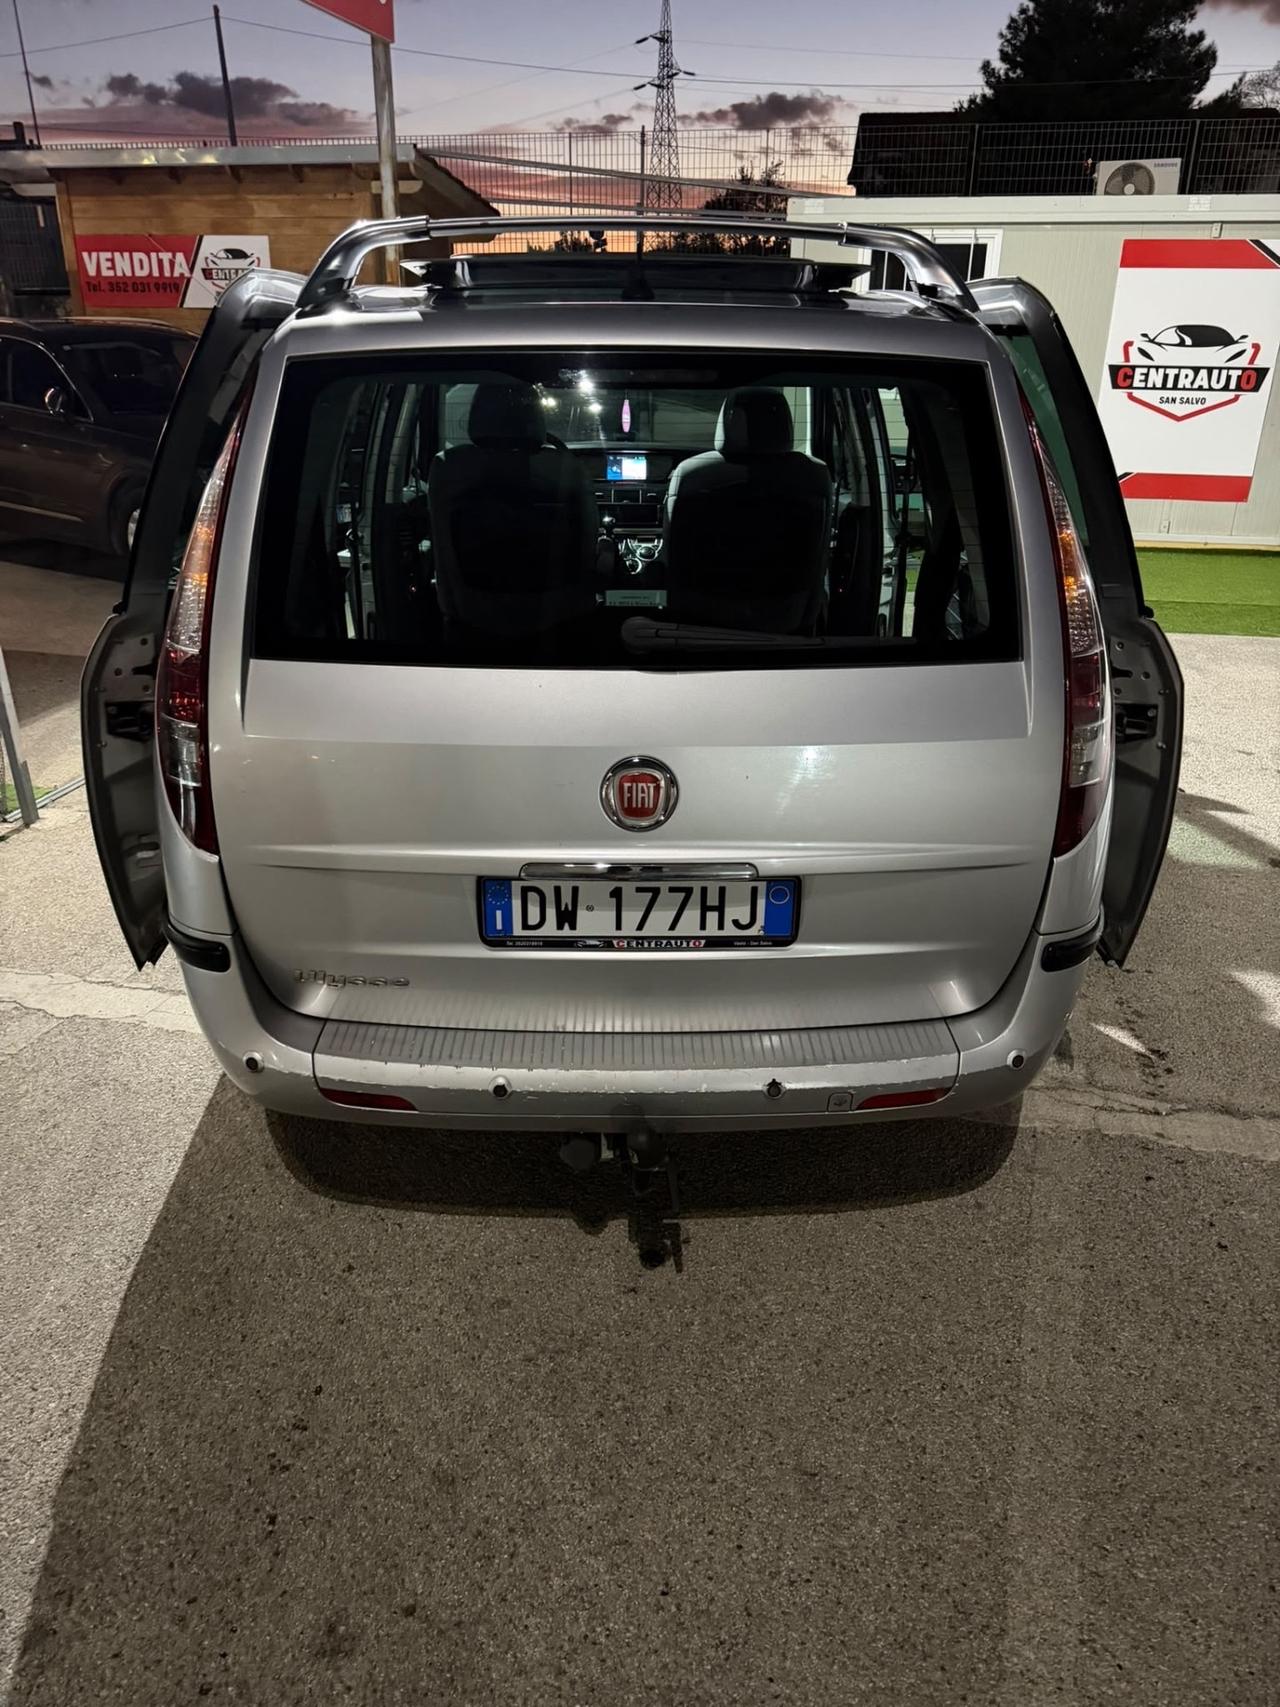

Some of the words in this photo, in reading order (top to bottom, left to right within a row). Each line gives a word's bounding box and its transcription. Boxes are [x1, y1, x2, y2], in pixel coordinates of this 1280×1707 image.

[81, 252, 192, 278] VENDITA
[86, 281, 104, 293] Tel.
[108, 281, 129, 293] 352
[131, 281, 151, 293] 031
[154, 281, 180, 294] 9919
[1117, 367, 1257, 391] CENTRAUTO
[1159, 396, 1177, 405] SAN
[1178, 397, 1206, 405] SALVO
[623, 782, 657, 809] FIAT
[520, 885, 580, 932] DW
[608, 885, 759, 932] 177HJ
[616, 940, 703, 948] CENTRAUTO
